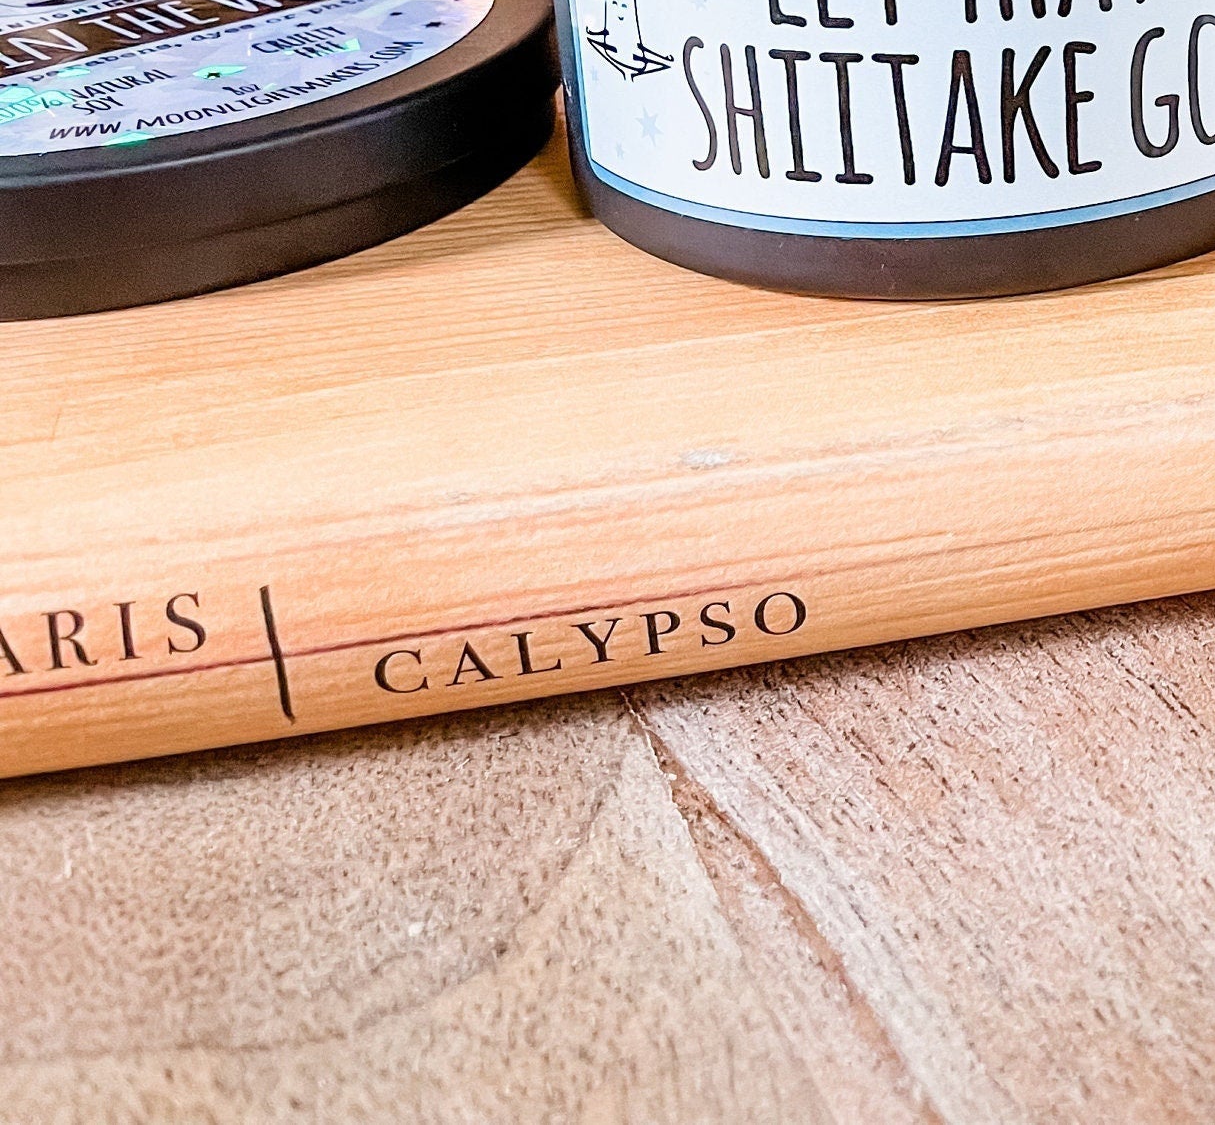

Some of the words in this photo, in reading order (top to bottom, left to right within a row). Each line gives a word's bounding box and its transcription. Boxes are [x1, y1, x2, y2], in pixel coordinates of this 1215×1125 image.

[78, 0, 219, 40] THE
[251, 25, 347, 54] CRUELTY
[70, 69, 178, 103] NATURAL
[72, 96, 124, 116] SOY
[681, 35, 1103, 189] SHIITAKE
[374, 590, 807, 695] CALYPSO
